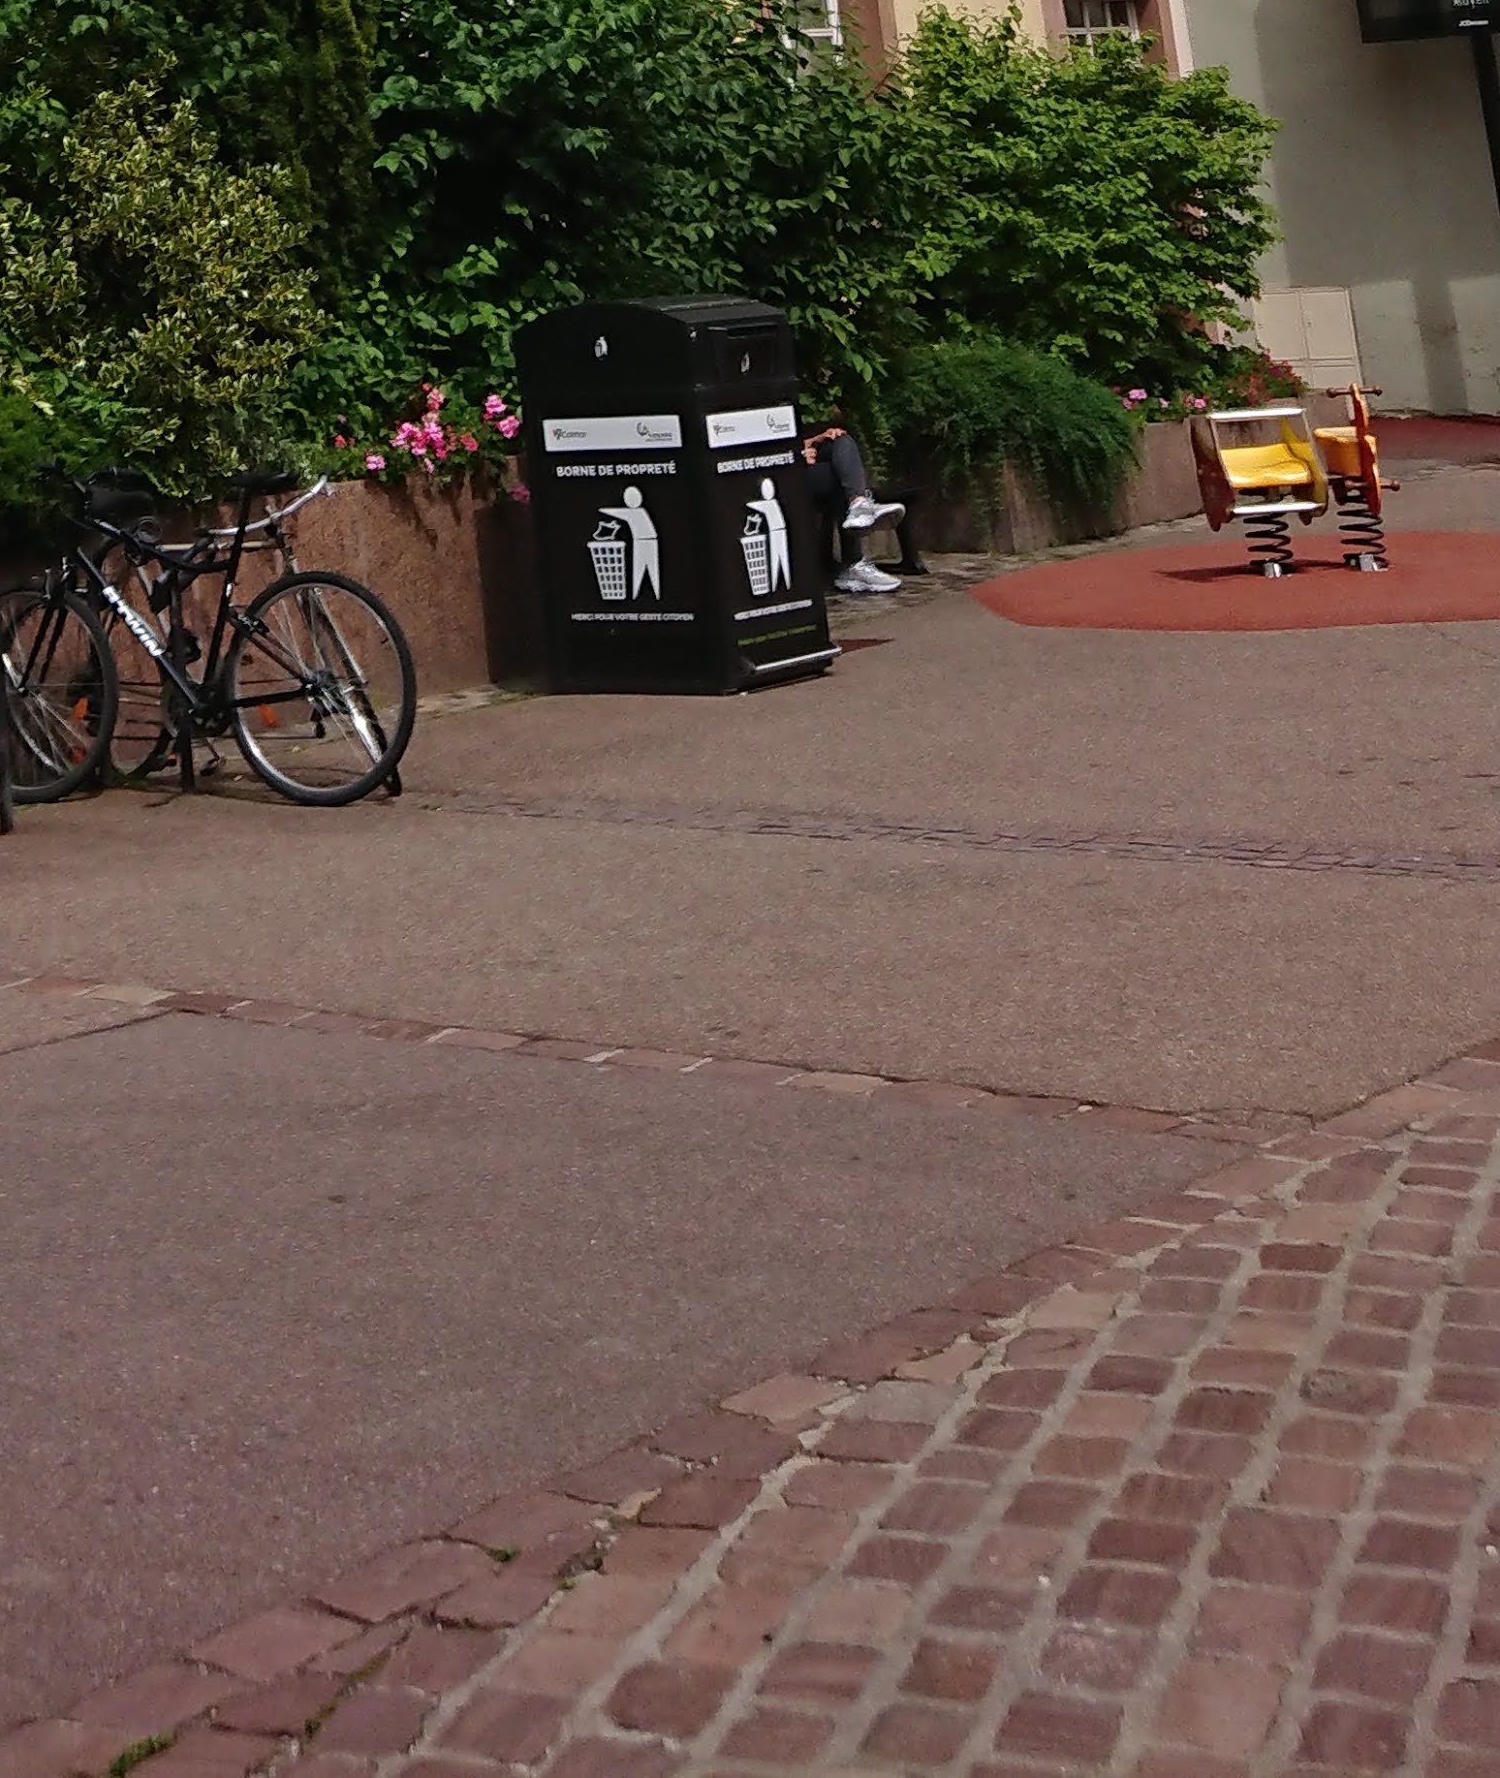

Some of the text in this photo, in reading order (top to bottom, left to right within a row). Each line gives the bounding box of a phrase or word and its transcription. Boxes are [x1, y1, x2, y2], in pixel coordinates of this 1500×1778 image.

[556, 460, 676, 477] BORNE DE PROPRETÉ
